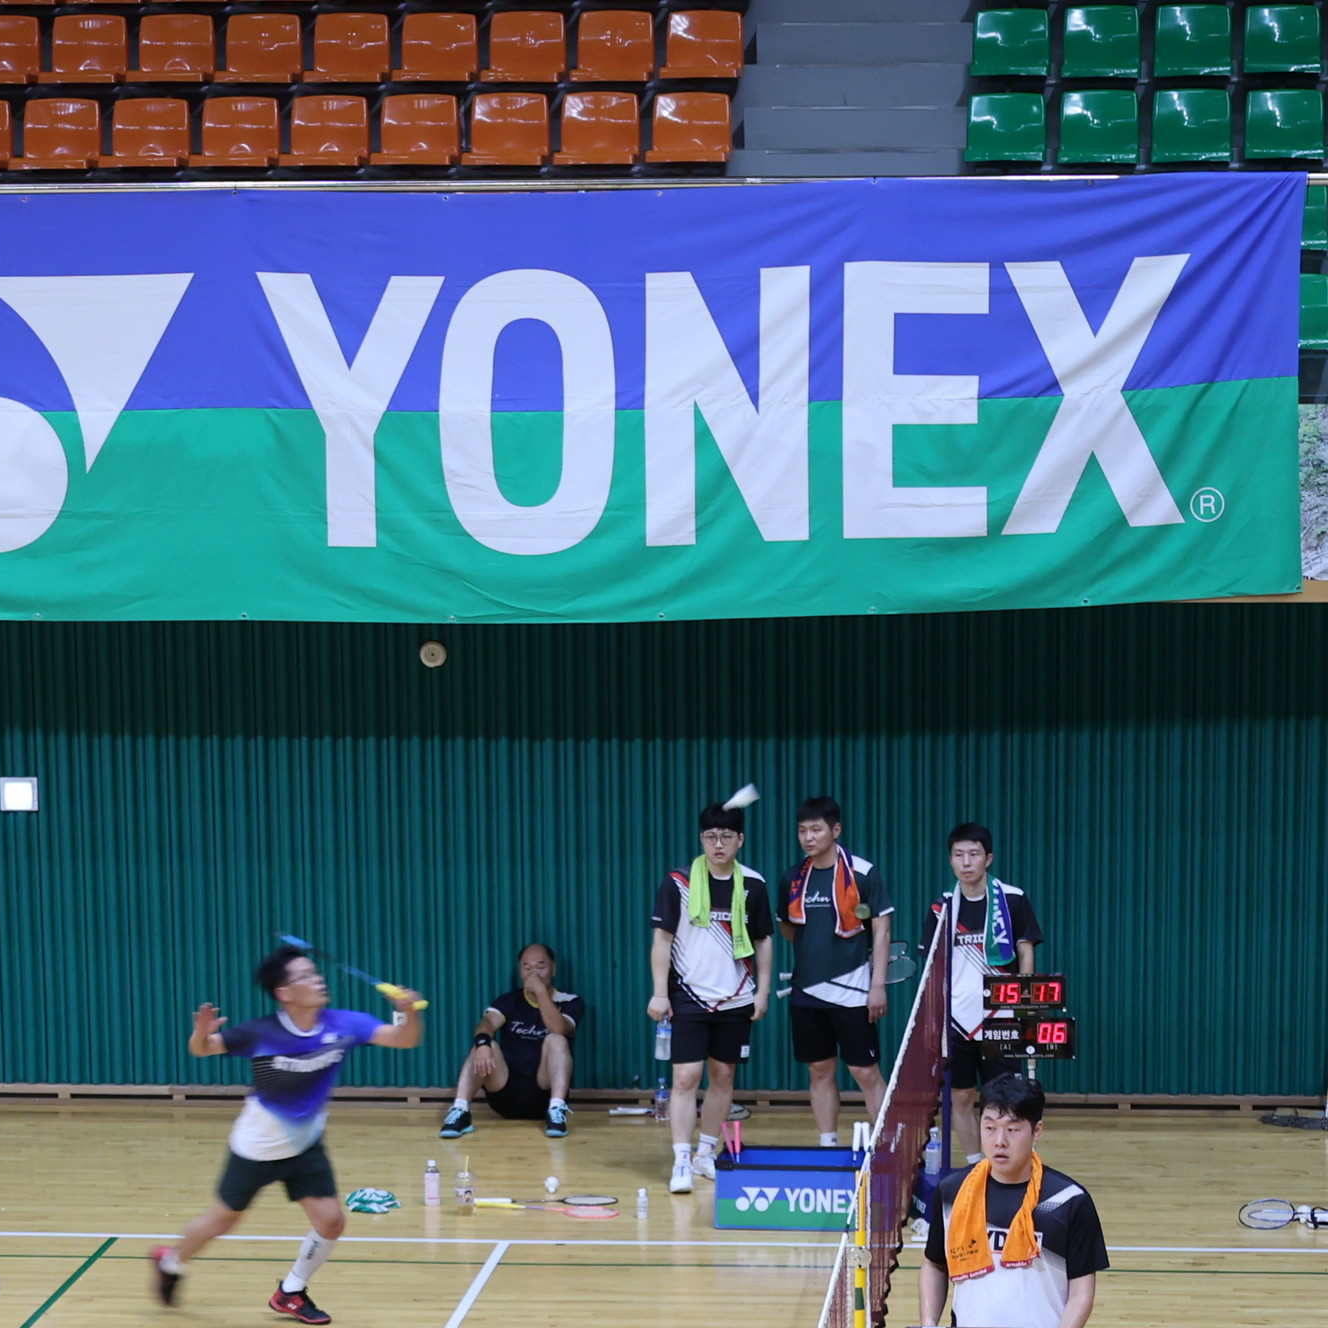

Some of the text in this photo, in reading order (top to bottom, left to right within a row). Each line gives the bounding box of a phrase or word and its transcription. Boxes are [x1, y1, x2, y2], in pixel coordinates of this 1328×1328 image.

[257, 254, 1189, 557] YONEX
[1000, 982, 1062, 1004] 15 17
[984, 1023, 1067, 1044] 게임번호 06
